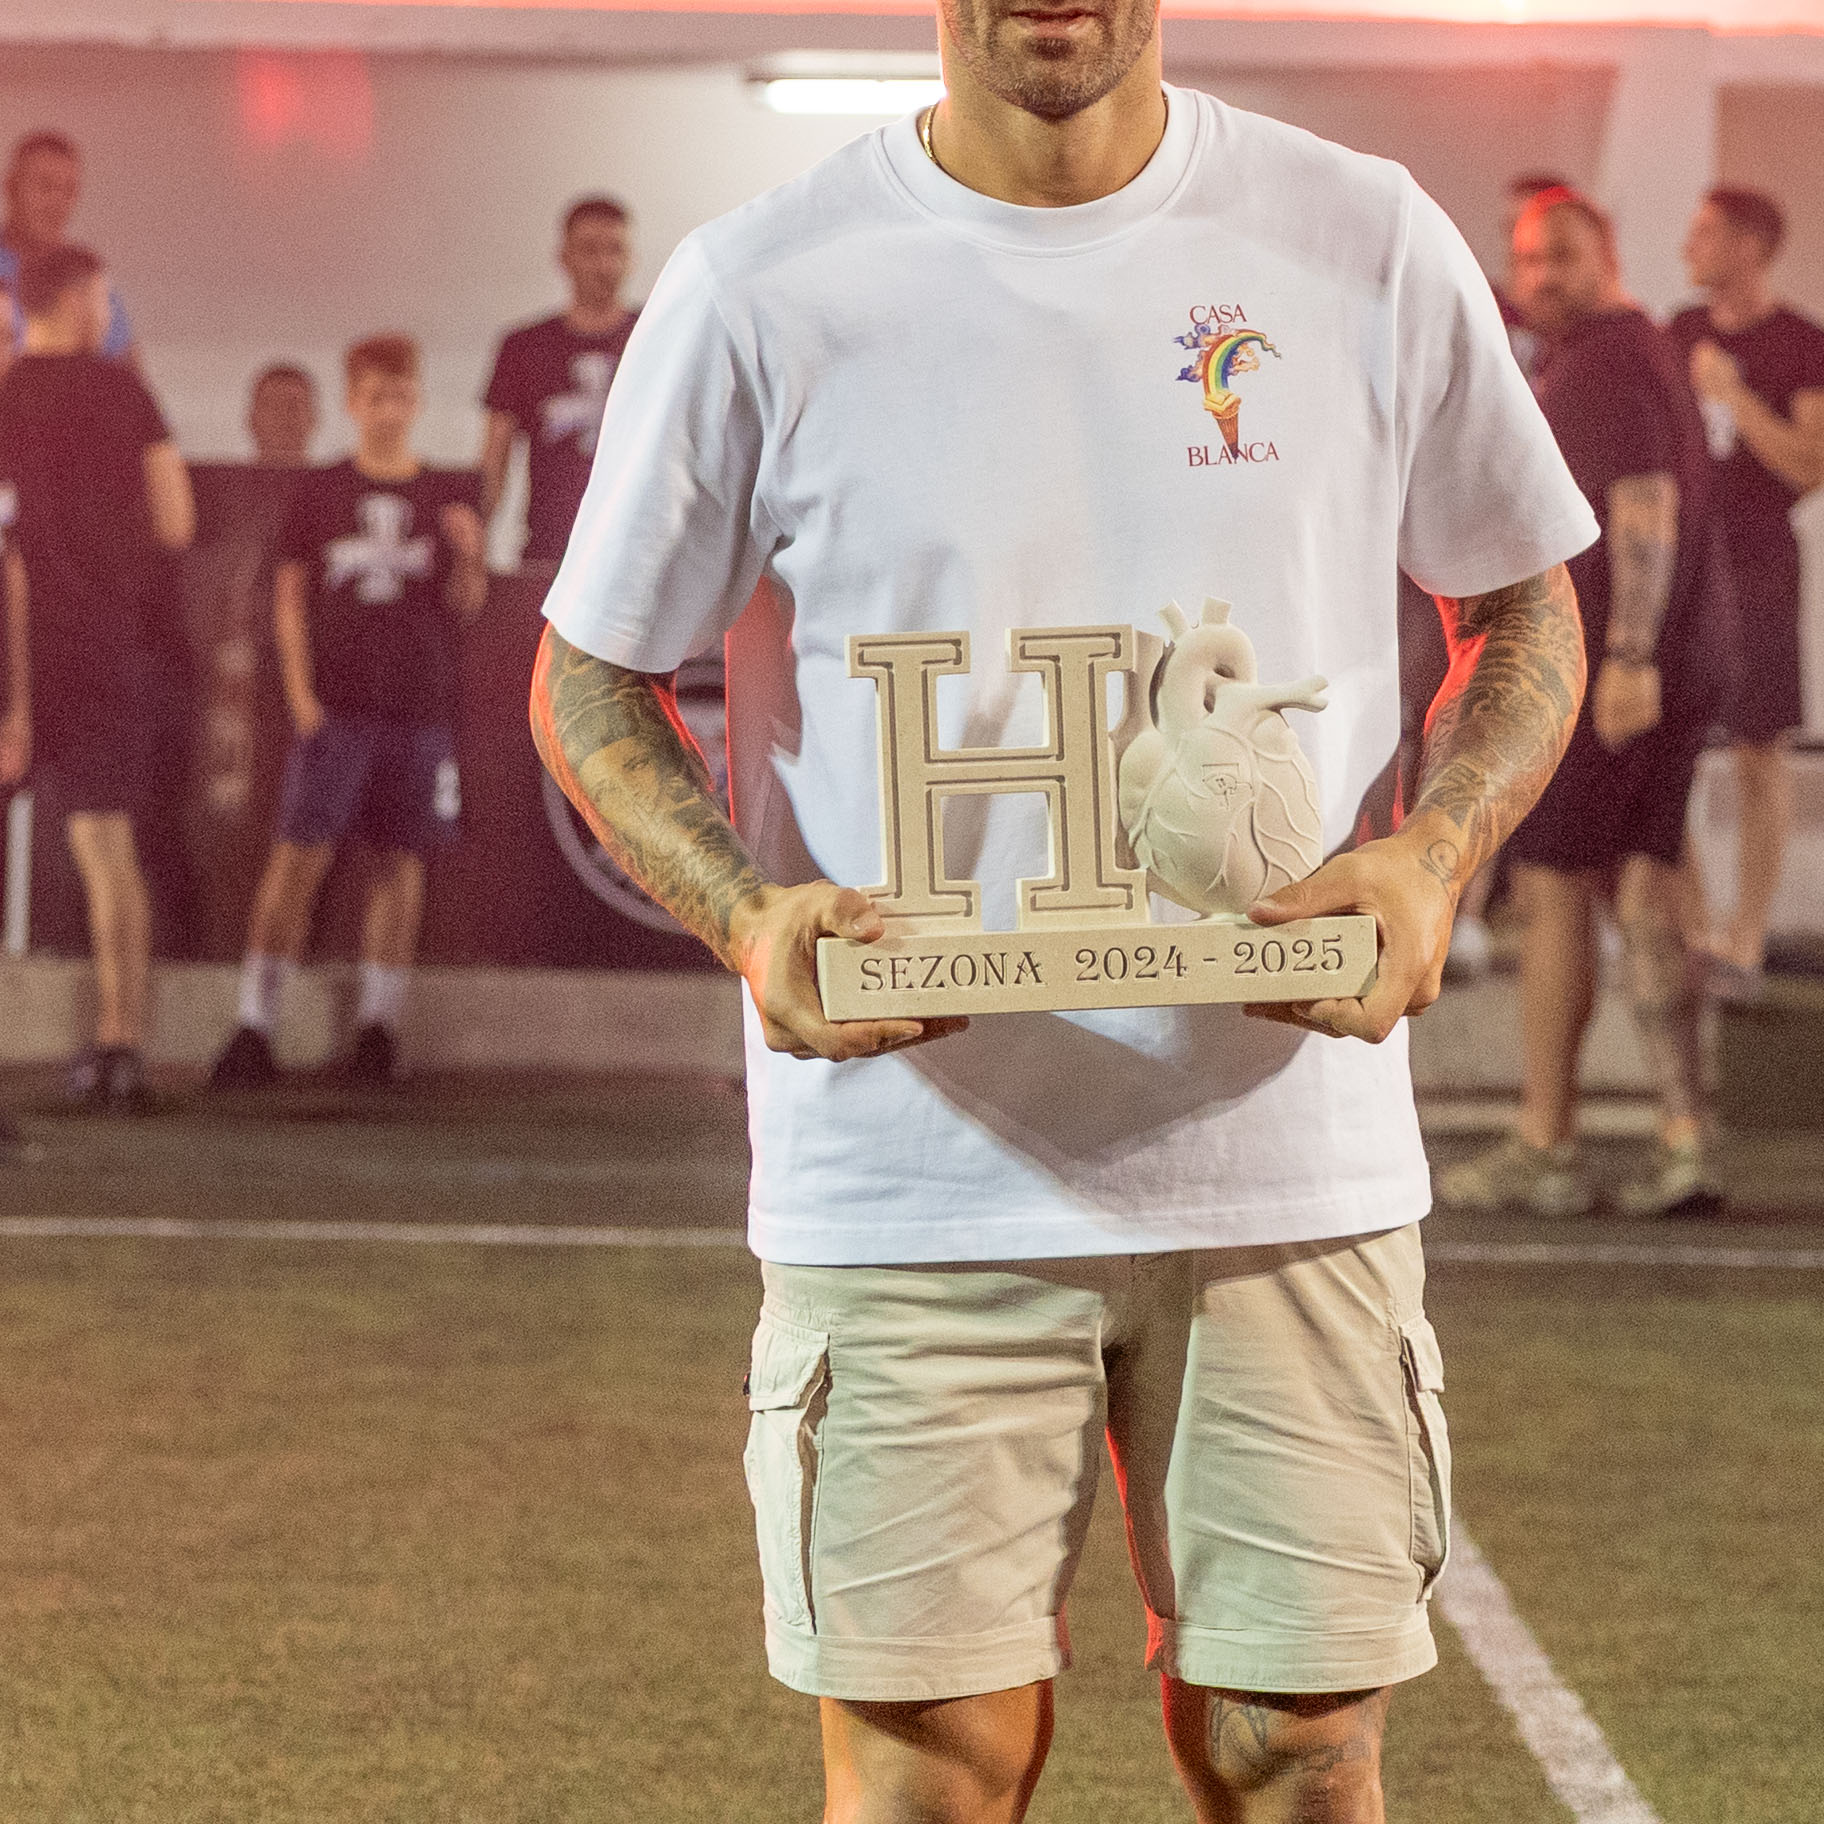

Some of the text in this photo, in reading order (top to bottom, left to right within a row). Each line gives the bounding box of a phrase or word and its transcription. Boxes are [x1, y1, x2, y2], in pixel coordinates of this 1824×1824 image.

[1189, 303, 1248, 325] CASA
[1187, 441, 1280, 467] BLANCA
[844, 623, 1150, 937] H
[860, 951, 1044, 991] SEZONA
[1075, 945, 1188, 982] 2024
[1233, 934, 1345, 975] 2025
